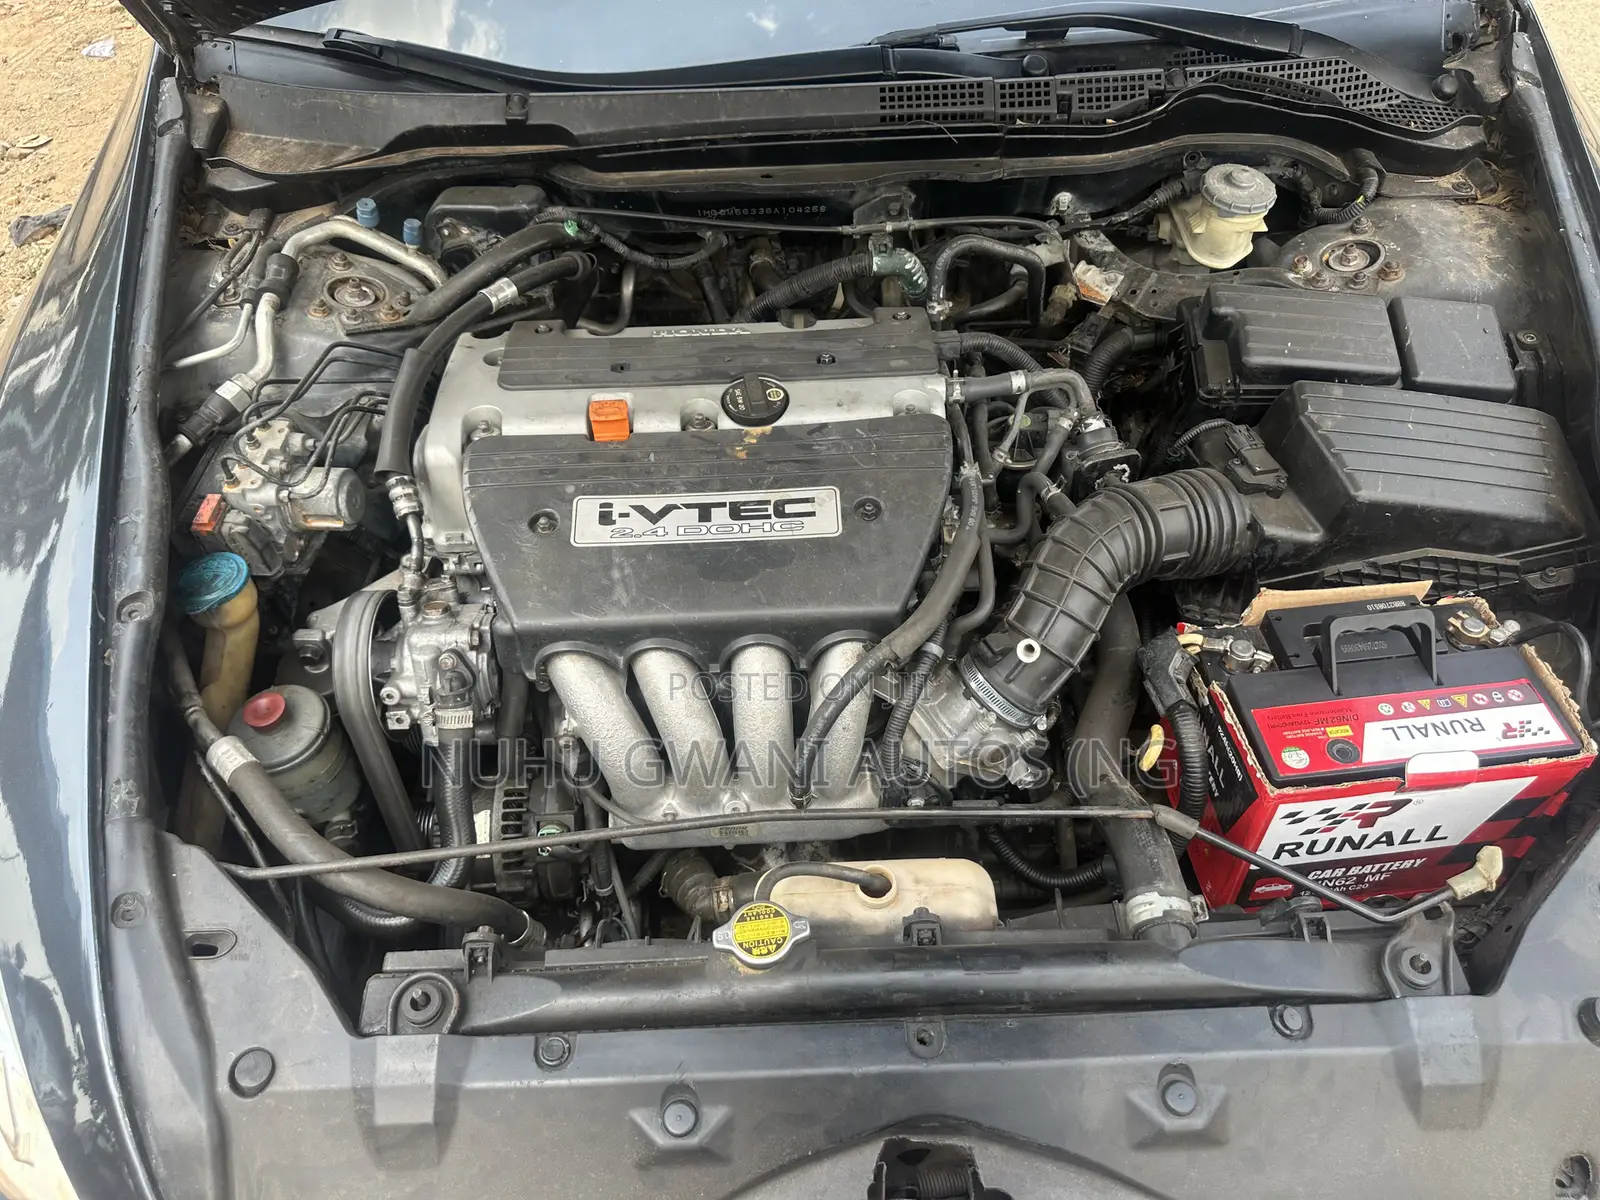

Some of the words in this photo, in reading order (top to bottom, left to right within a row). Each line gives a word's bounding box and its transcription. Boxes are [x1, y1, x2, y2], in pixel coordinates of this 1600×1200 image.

[652, 328, 751, 338] HONDA
[598, 496, 817, 526] i-VTEC
[610, 526, 669, 539] 2.4
[676, 520, 805, 537] DOHC
[1314, 717, 1329, 725] MF
[1331, 713, 1359, 722] DIN62
[1382, 716, 1484, 742] RUNALL
[1272, 825, 1449, 860] RUNALL
[1307, 866, 1348, 881] CAR
[1350, 857, 1427, 876] BATTERY
[1364, 872, 1392, 883] MF
[1348, 883, 1369, 891] C20
[743, 908, 776, 917] COOLANT
[746, 913, 774, 921] ENGINE
[742, 936, 783, 949] CAUTION
